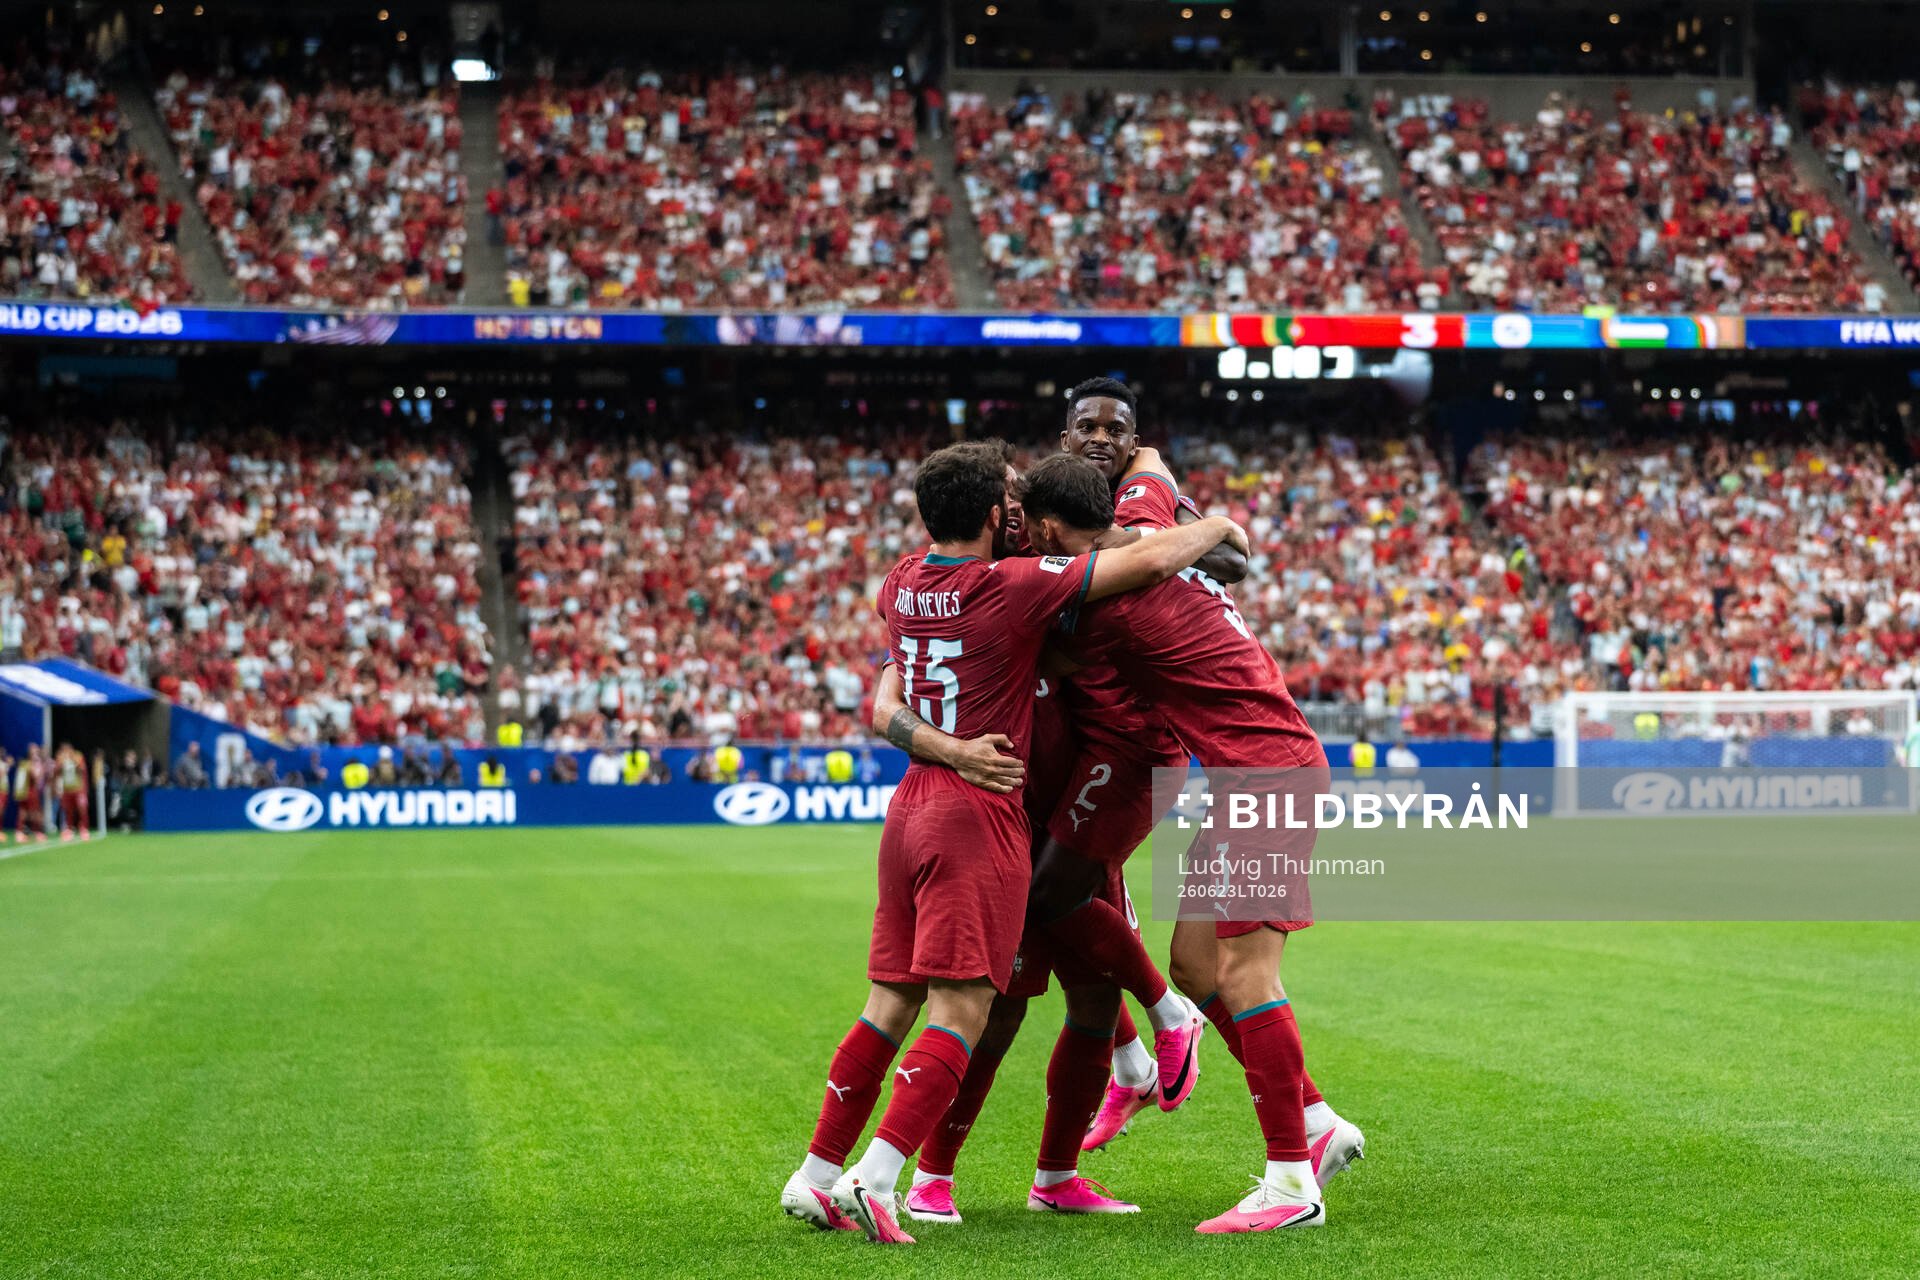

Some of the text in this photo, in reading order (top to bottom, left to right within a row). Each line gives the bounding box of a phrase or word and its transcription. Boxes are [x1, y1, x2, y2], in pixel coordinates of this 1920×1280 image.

[43, 306, 93, 331] CUP
[95, 309, 183, 335] 2026
[1401, 314, 1438, 348] 3
[1840, 320, 1891, 344] FIFA
[917, 590, 961, 617] NEVES
[899, 635, 963, 735] 15
[1075, 763, 1112, 811] 2
[1689, 774, 1863, 808] HYUNDAI
[329, 790, 517, 826] HYUNDAI
